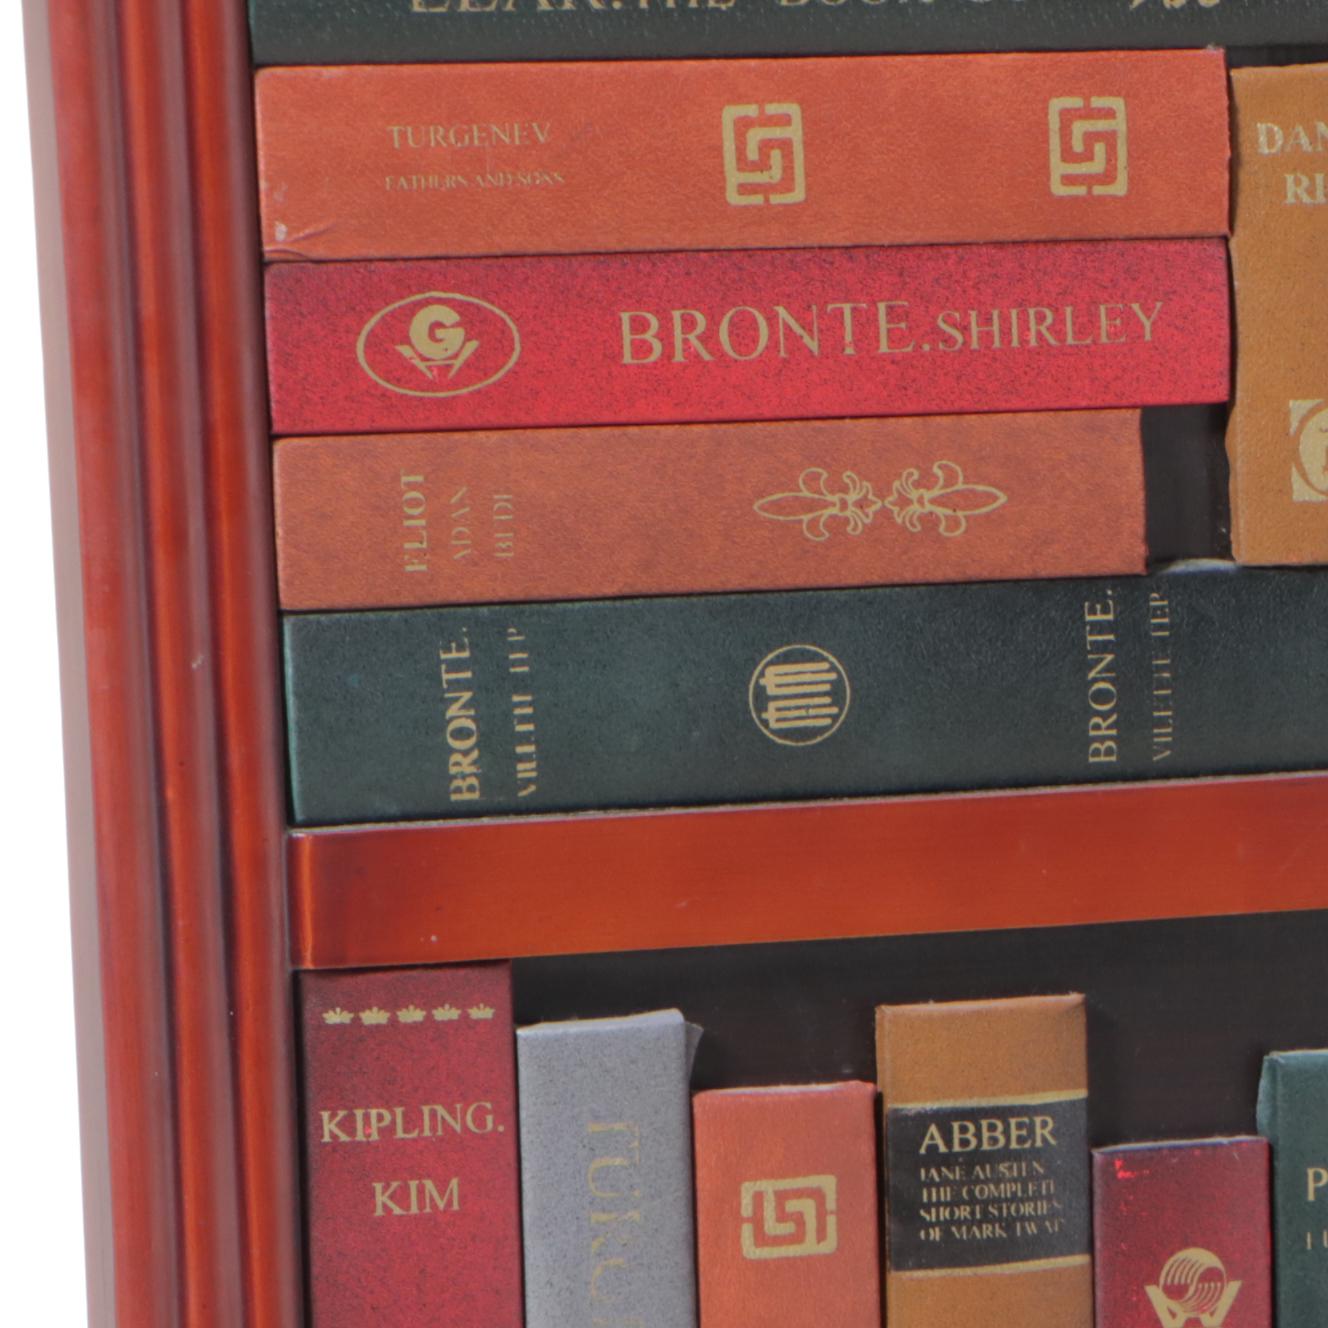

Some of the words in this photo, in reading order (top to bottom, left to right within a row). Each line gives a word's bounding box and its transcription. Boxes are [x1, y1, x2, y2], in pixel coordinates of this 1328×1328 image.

[385, 122, 551, 150] TURGENEV
[919, 1115, 1058, 1154] ABBER
[372, 1177, 460, 1217] KIM
